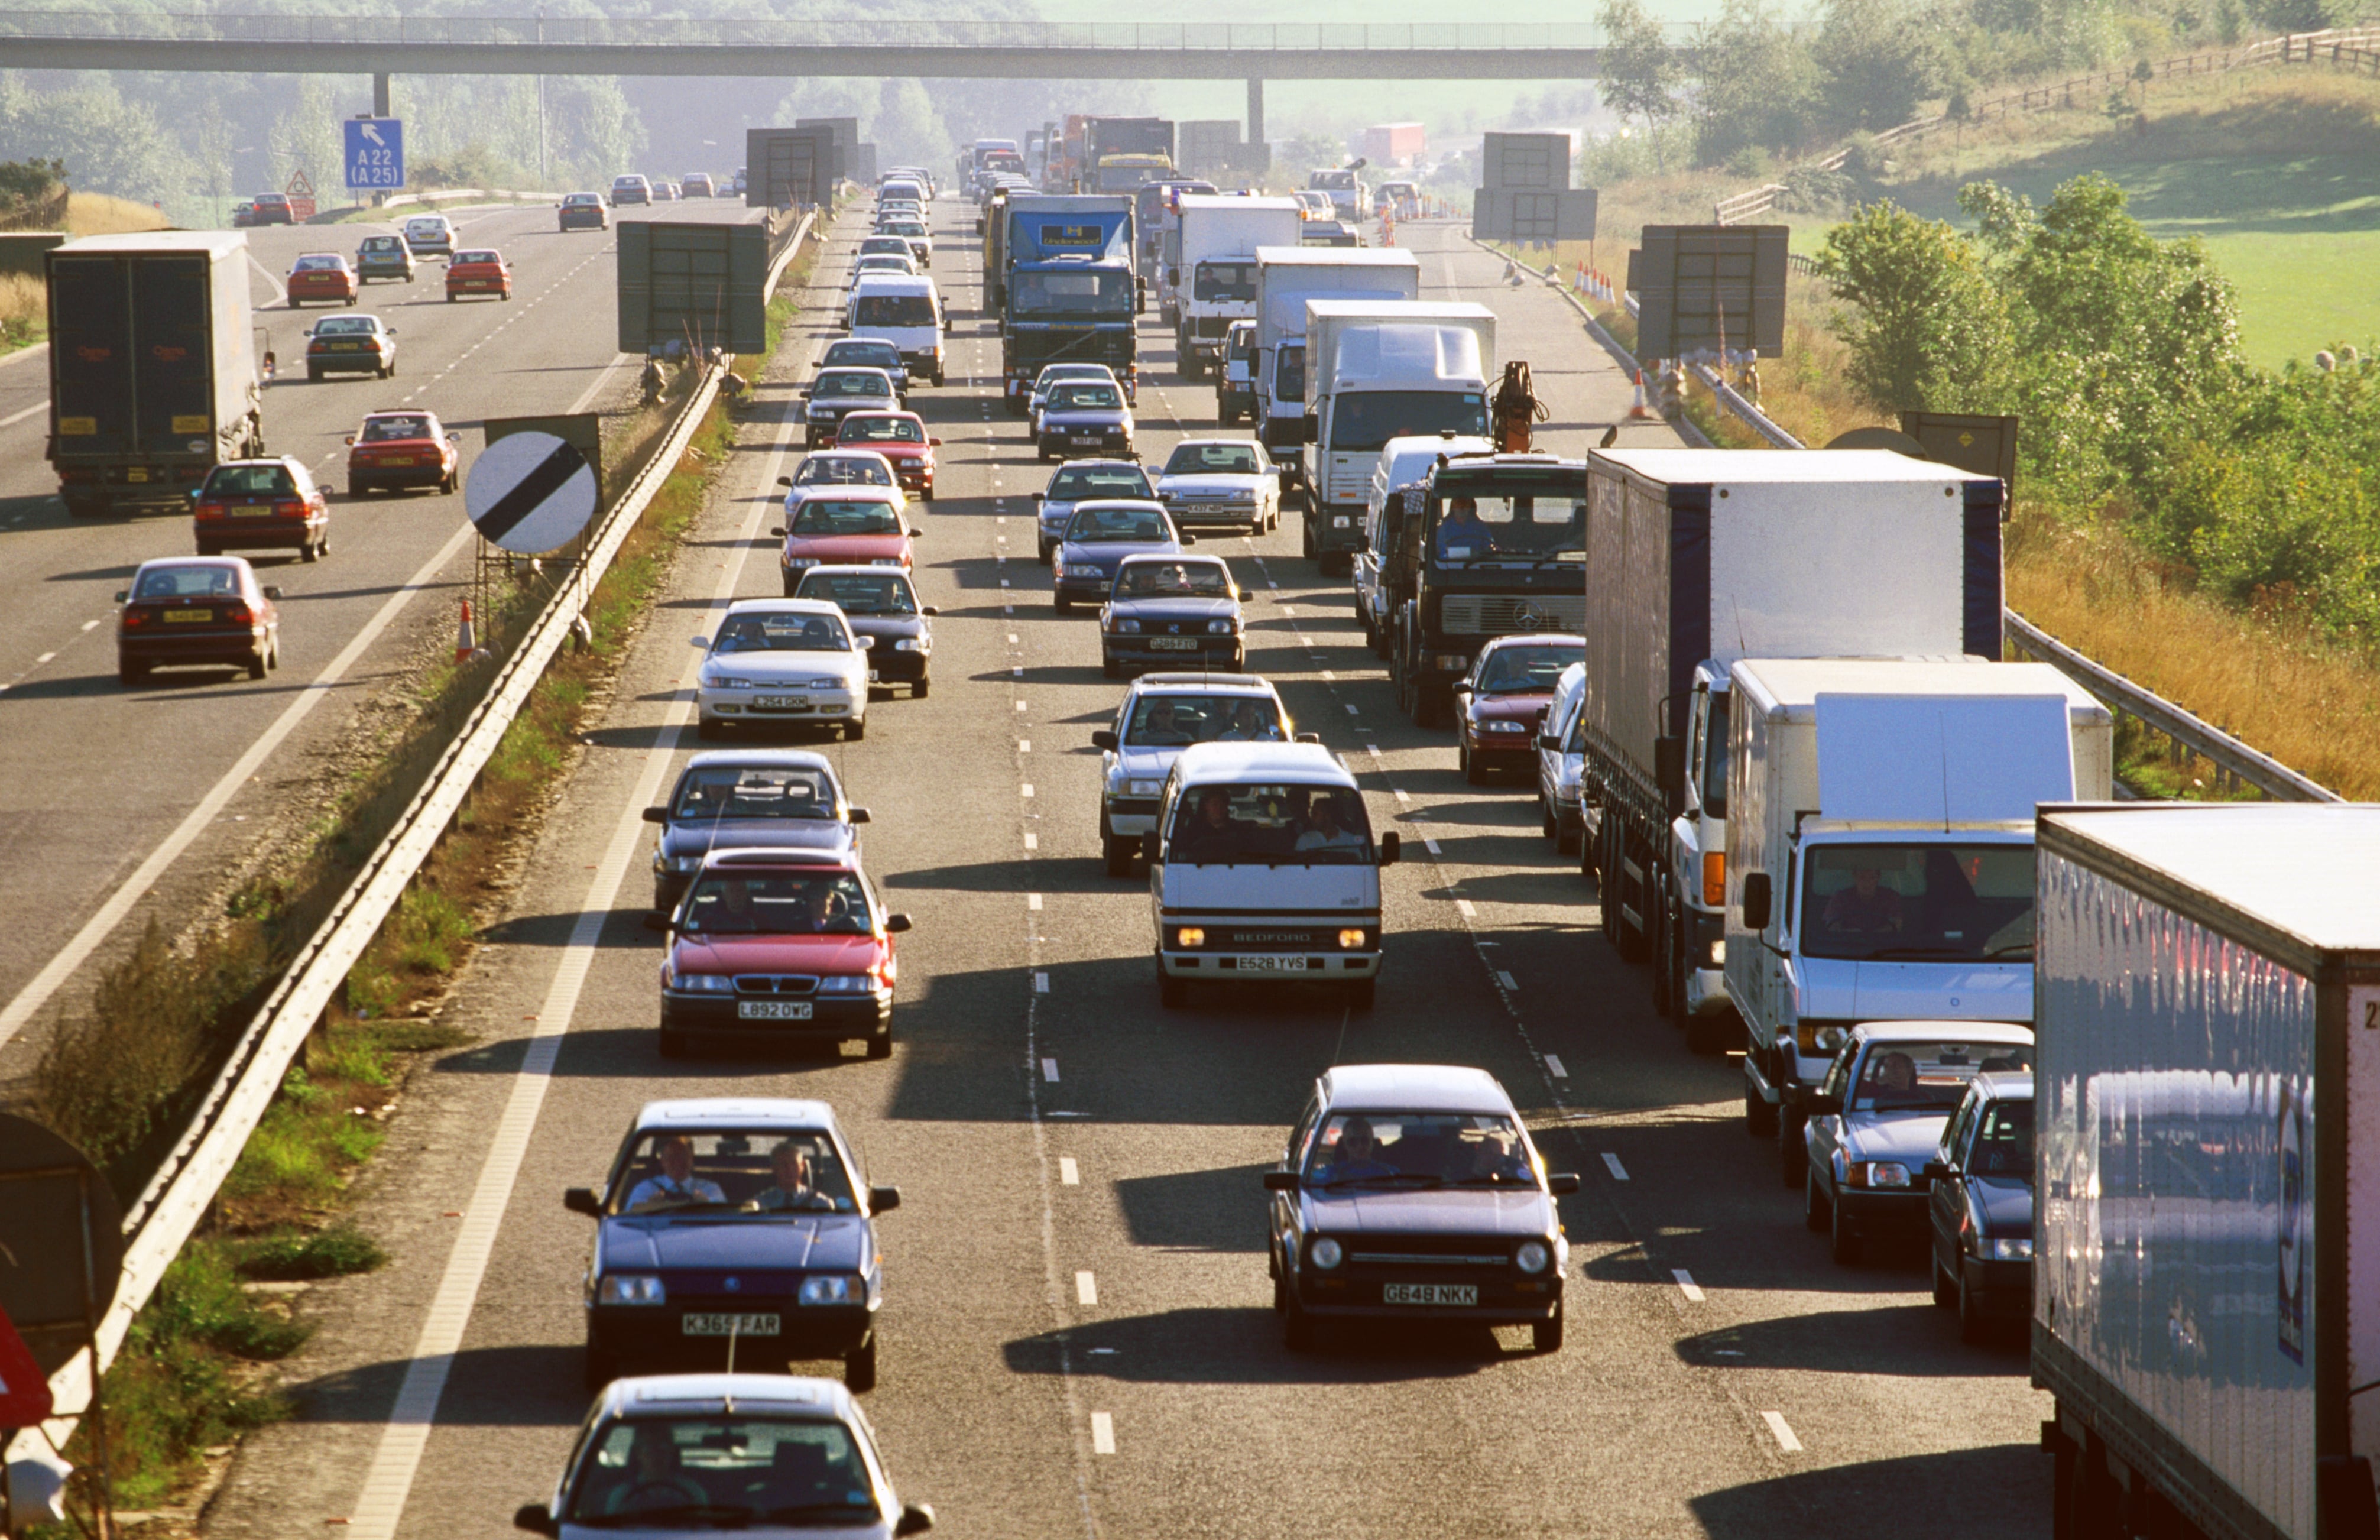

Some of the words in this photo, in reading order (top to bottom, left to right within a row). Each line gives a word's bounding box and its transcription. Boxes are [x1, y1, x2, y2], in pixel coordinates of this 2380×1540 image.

[1234, 933, 1311, 942] BEDFORD
[1240, 957, 1275, 969] E528
[1278, 957, 1304, 969] YVS
[741, 1004, 779, 1016] L892
[782, 1004, 810, 1016] OWG
[2366, 1001, 2380, 1029] 2
[1438, 1287, 1475, 1302] NKK
[741, 1314, 777, 1331] FAR
